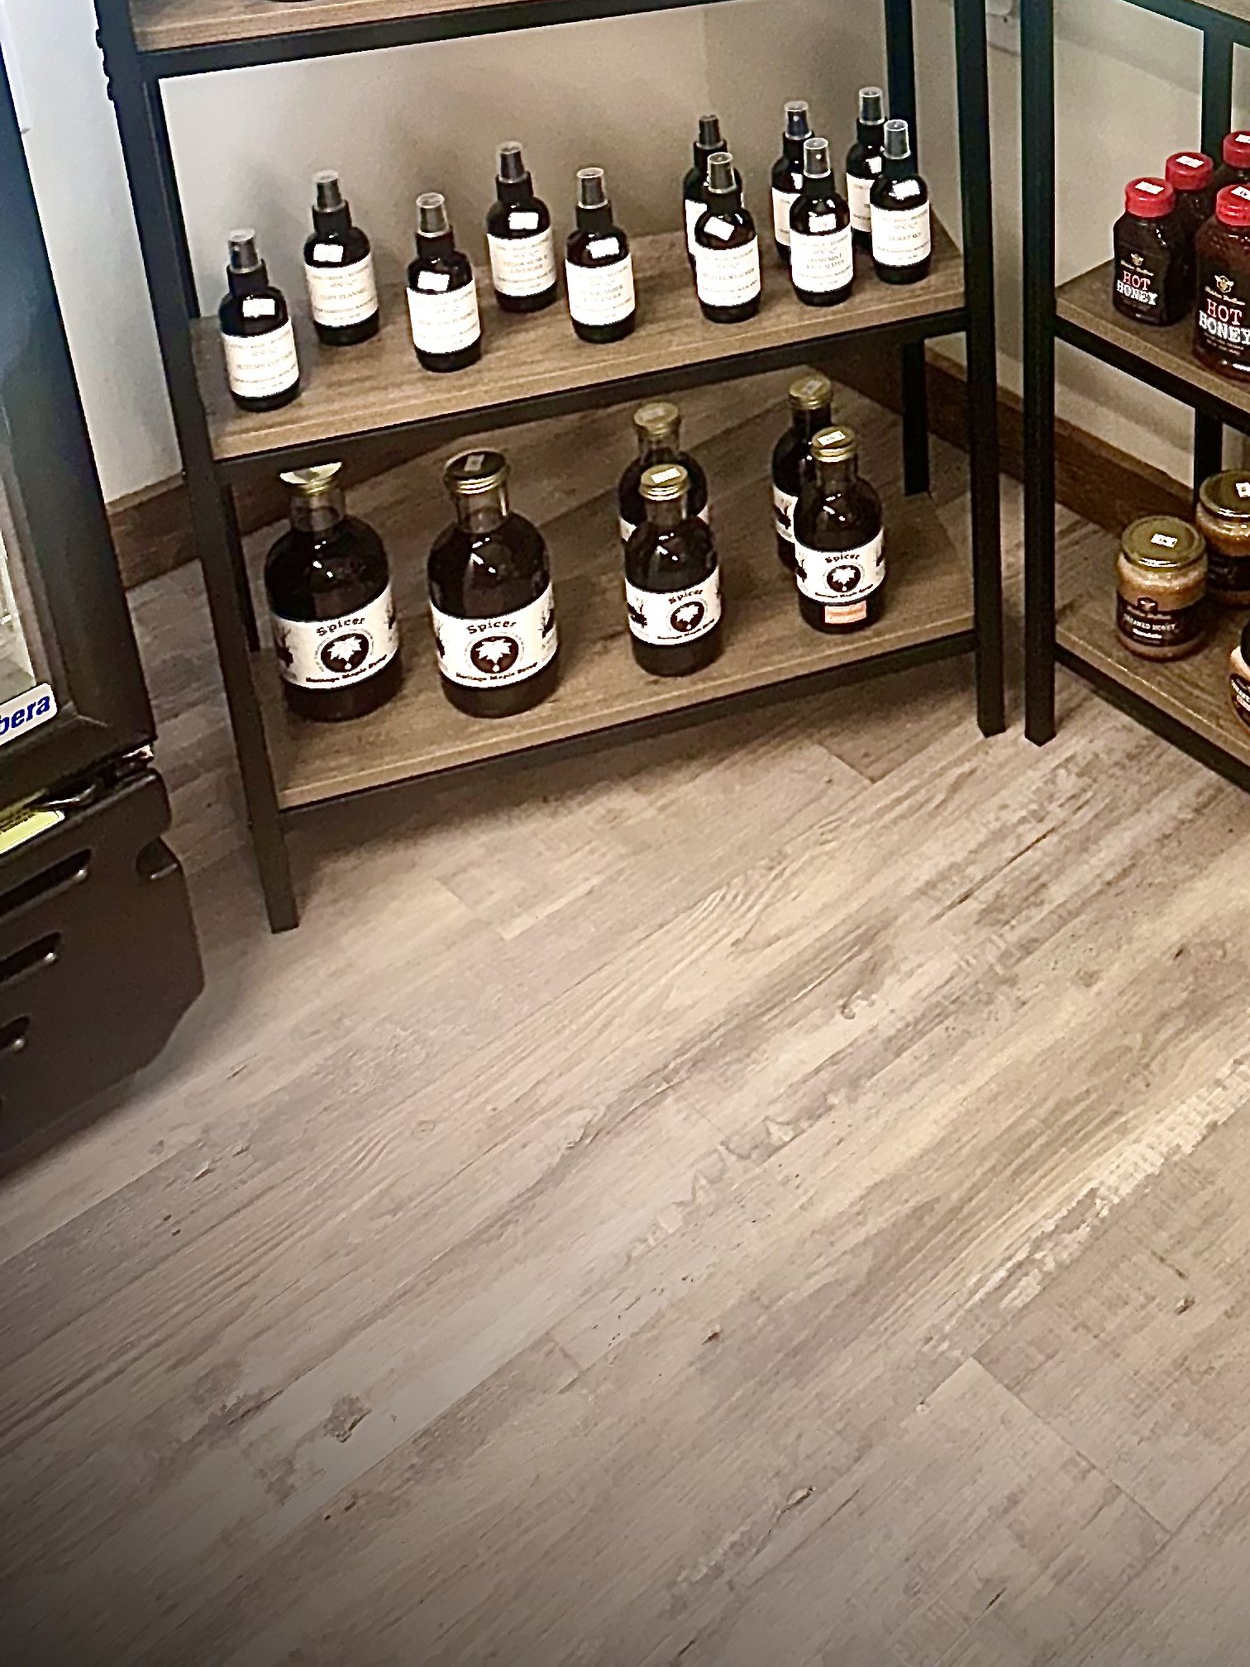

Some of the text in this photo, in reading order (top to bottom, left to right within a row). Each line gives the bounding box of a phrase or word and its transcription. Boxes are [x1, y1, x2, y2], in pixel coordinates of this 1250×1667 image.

[1122, 270, 1151, 291] HOT
[1116, 279, 1159, 307] HONEY
[1206, 298, 1243, 326] HOT
[316, 617, 366, 637] Spicer
[465, 619, 517, 635] Spicer
